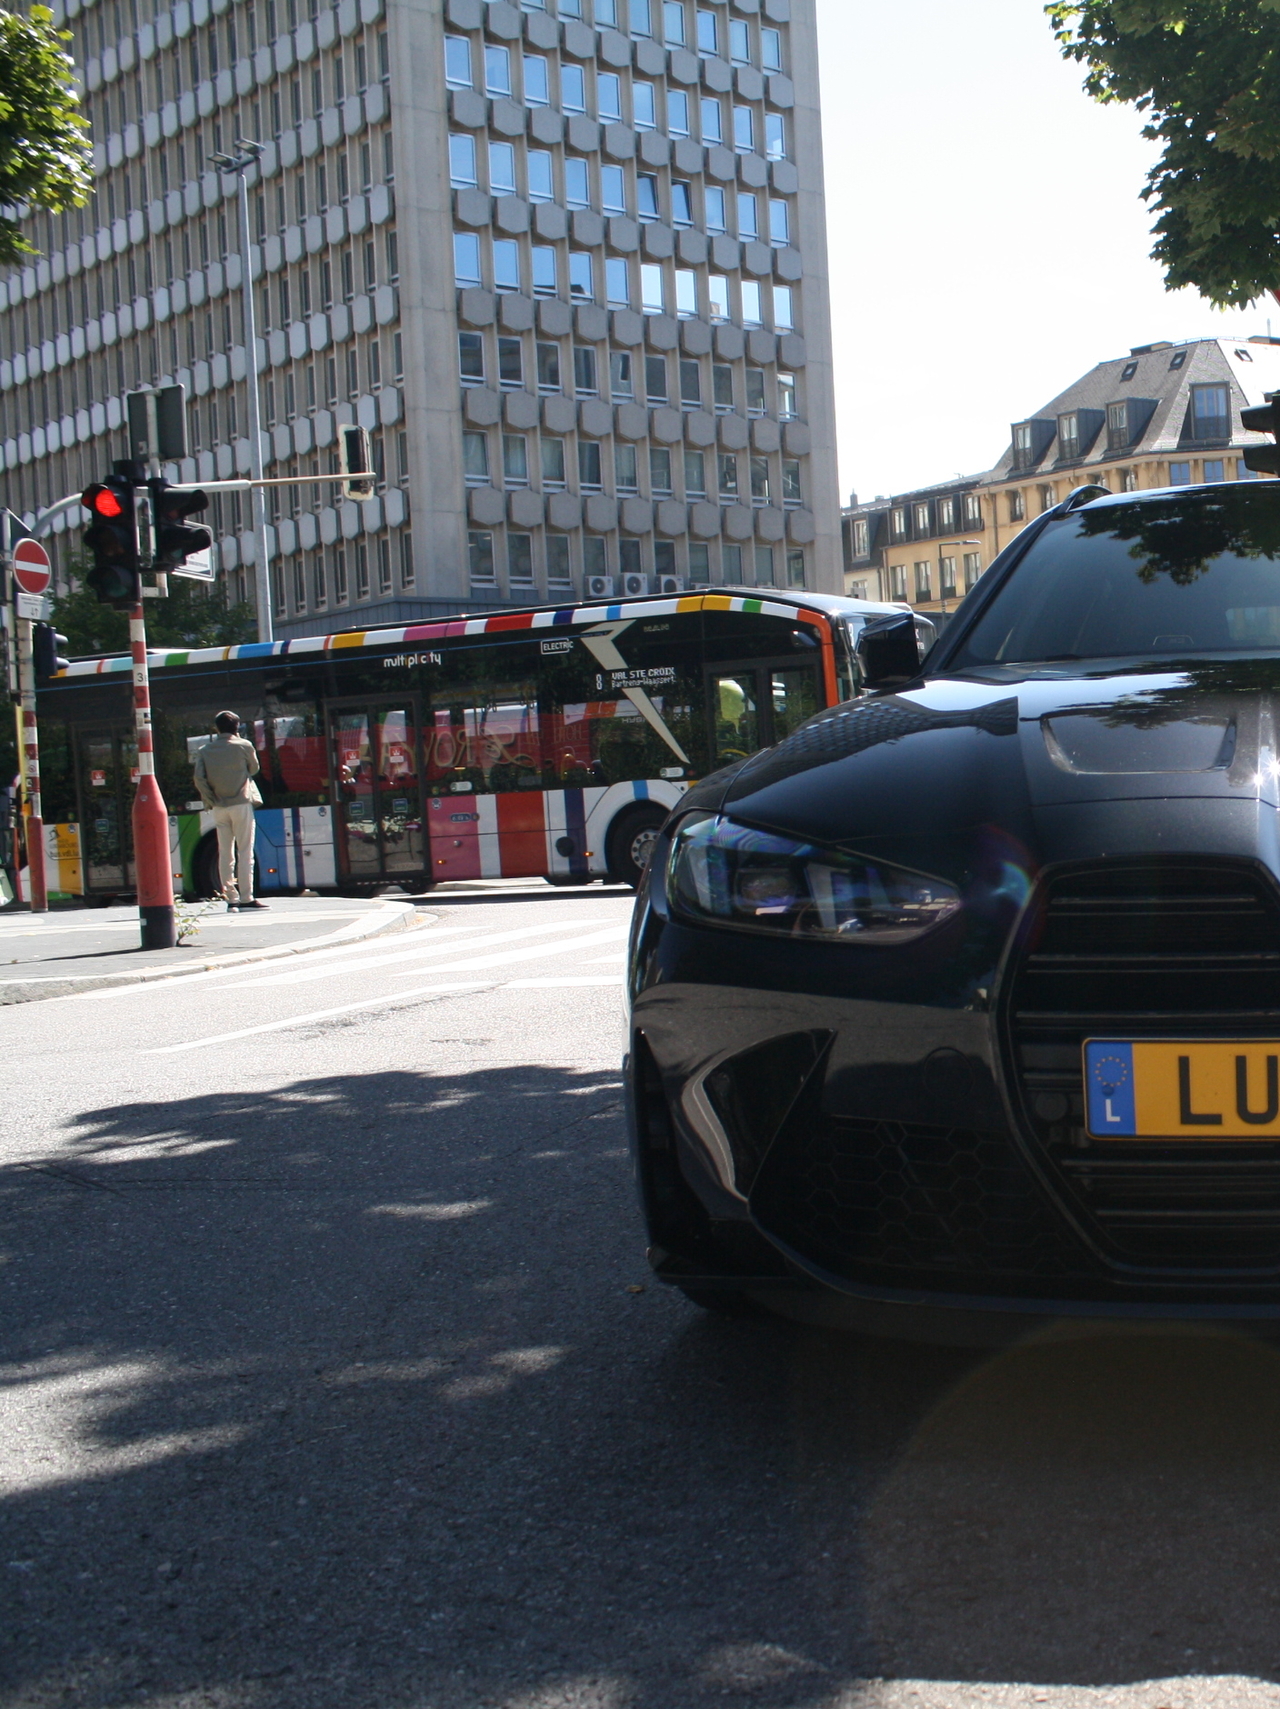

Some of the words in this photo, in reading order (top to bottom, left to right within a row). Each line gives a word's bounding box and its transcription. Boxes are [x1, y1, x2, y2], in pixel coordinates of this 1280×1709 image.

[543, 640, 574, 651] ELECTRIC
[611, 671, 628, 680] VAL
[629, 669, 646, 678] STE
[647, 666, 676, 677] CROIX
[596, 673, 603, 690] 8
[1105, 1099, 1120, 1122] L
